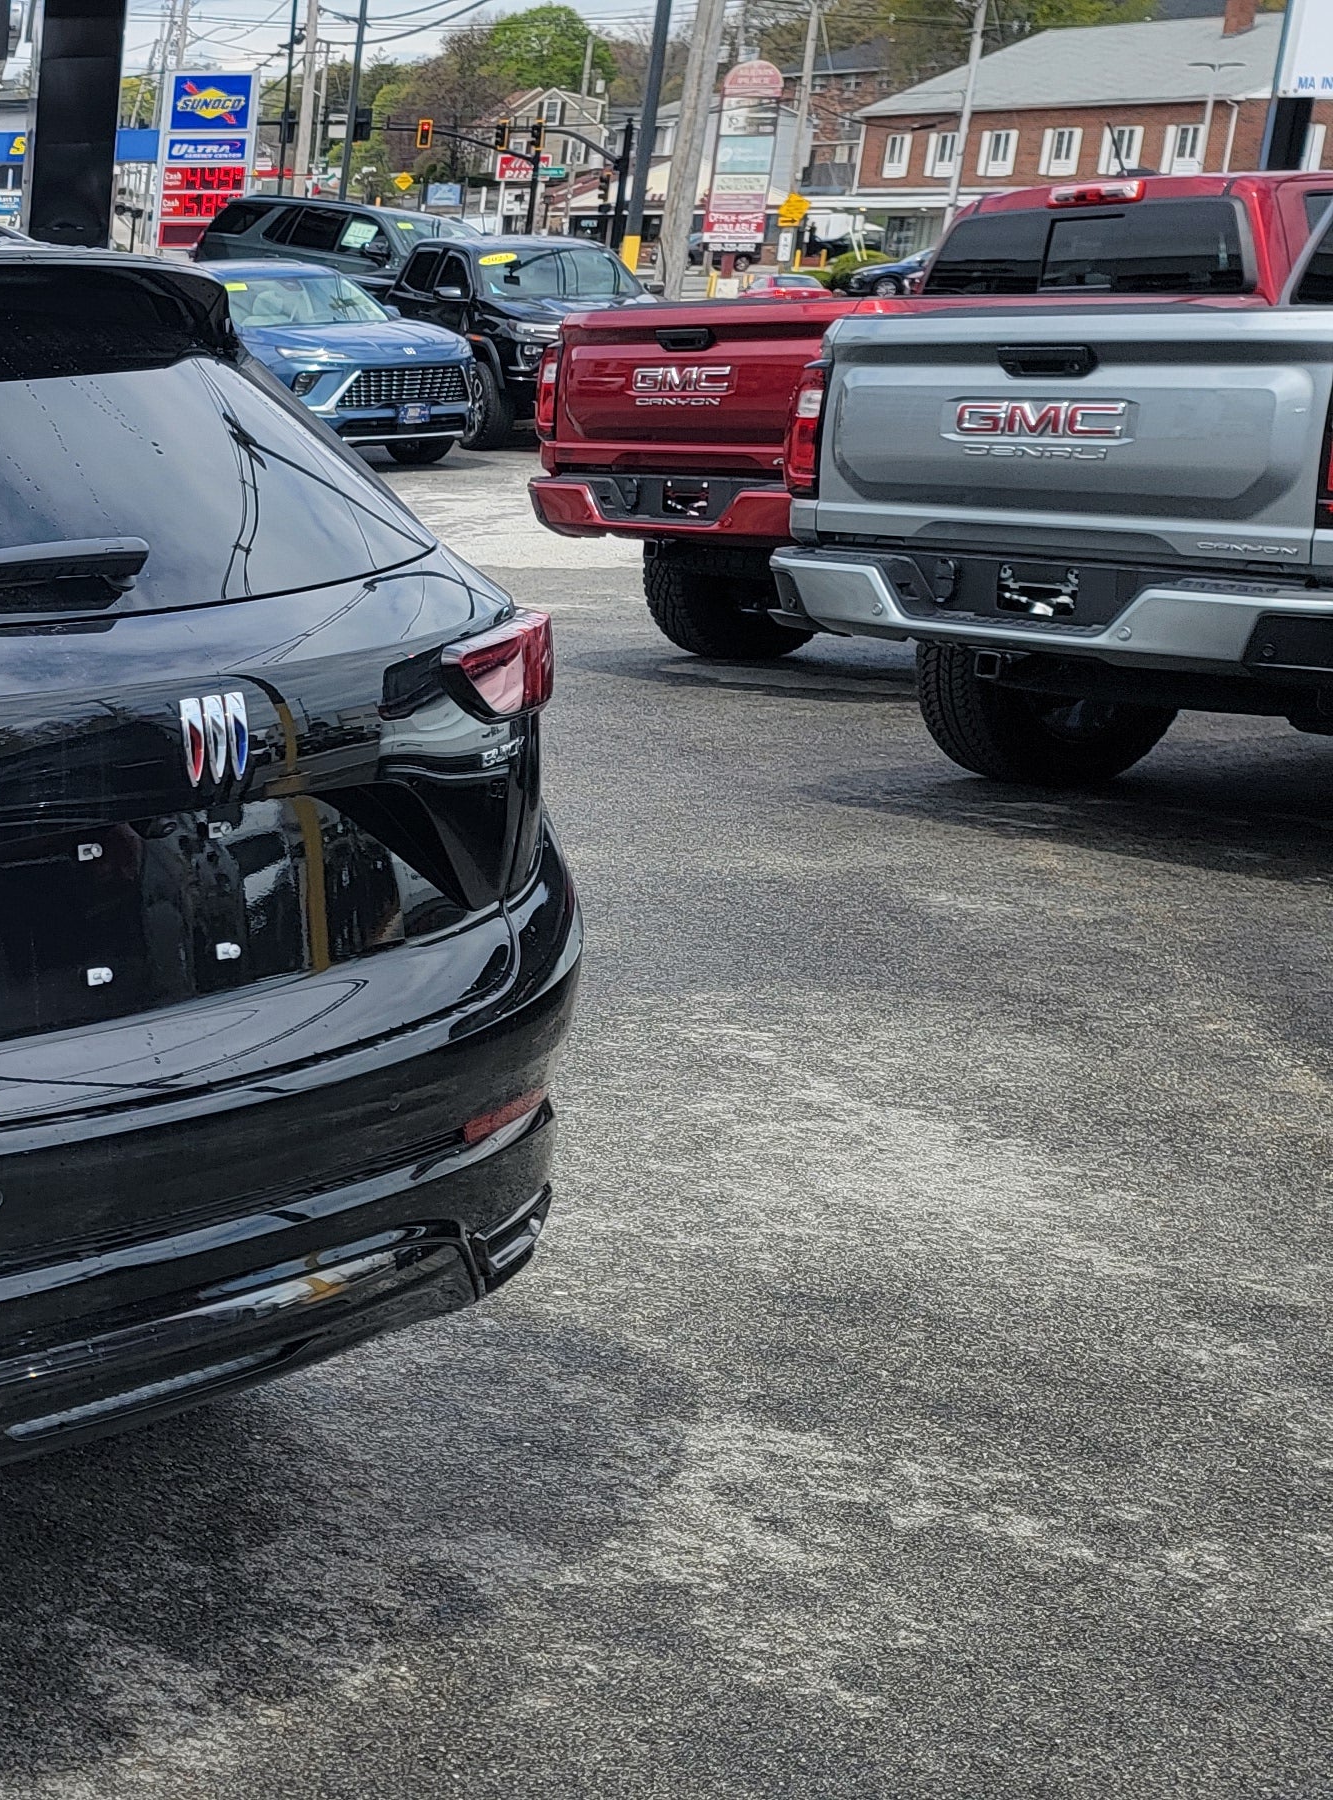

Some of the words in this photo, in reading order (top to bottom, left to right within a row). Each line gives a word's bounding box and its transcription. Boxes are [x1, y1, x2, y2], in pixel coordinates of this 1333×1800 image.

[1320, 76, 1333, 90] IN
[177, 97, 245, 111] SUNOCO
[170, 143, 231, 156] ULTRA
[633, 365, 731, 392] GMC
[635, 397, 721, 406] CANYON
[956, 401, 1126, 437] GMC
[962, 443, 1108, 460] DENALI
[1196, 541, 1299, 556] CANYON
